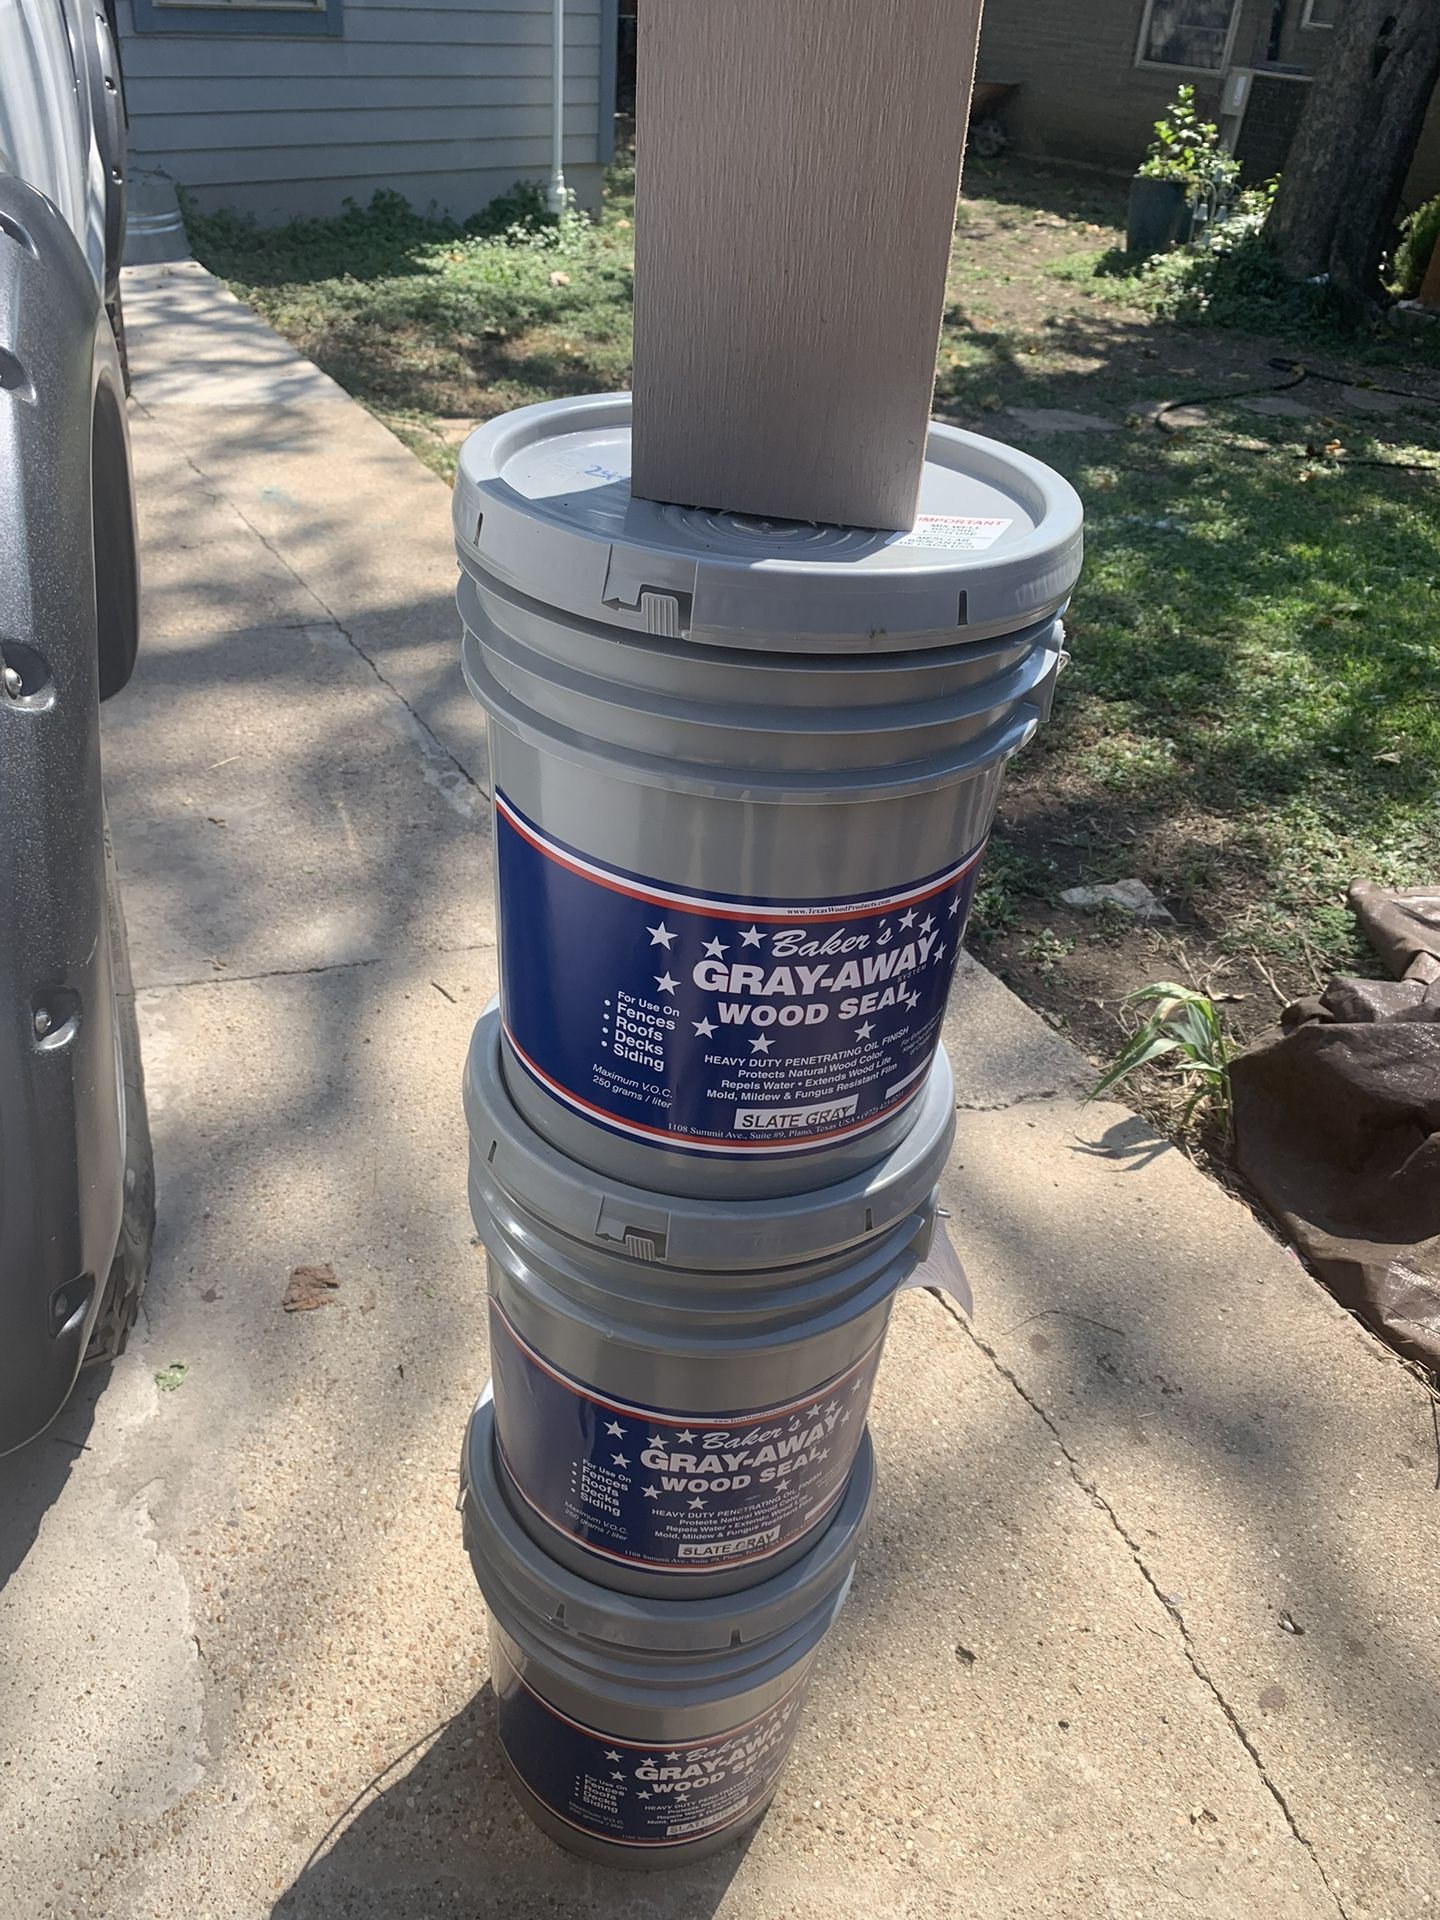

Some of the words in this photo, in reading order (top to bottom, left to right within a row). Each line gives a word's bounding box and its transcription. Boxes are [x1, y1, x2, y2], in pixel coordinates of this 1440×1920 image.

[918, 517, 1003, 526] IMPORTANT
[787, 898, 892, 915] www.TexasWoodProducts.com
[771, 918, 894, 958] Baker's
[692, 928, 940, 996] GRAY-AWAY
[617, 990, 636, 1004] For
[638, 998, 660, 1012] Use
[663, 1006, 680, 1017] On
[617, 1001, 676, 1030] Fences
[717, 1001, 830, 1027] WOOD
[838, 982, 912, 1020] SEAL
[616, 1015, 663, 1042] Roofs
[614, 1029, 664, 1056] Decks
[704, 1054, 746, 1066] HEAVY
[749, 1059, 782, 1067] DUTY
[785, 1046, 862, 1067] PENETRATING
[864, 1041, 879, 1052] OIL
[881, 1026, 910, 1046] FINISH
[613, 1043, 665, 1072] Siding
[738, 1069, 785, 1079] Protects
[788, 1065, 827, 1078] Natural
[829, 1060, 857, 1073] Wood
[859, 1050, 884, 1064] Color
[592, 1063, 639, 1088] Maximum
[642, 1082, 673, 1099] V.O.C.
[706, 1089, 738, 1101] Mold,
[740, 1092, 780, 1101] Mildew
[783, 1092, 792, 1100] &
[795, 1087, 834, 1099] Fungus
[836, 1071, 880, 1092] Resistant
[881, 1063, 898, 1077] Film
[721, 1079, 760, 1091] Repels
[763, 1081, 795, 1090] Water
[805, 1072, 846, 1087] Extends
[848, 1064, 874, 1078] Wood
[876, 1056, 892, 1069] Life
[592, 1074, 611, 1089] 250
[612, 1085, 643, 1102] grams
[652, 1096, 673, 1109] liter
[668, 1122, 688, 1133] 1108
[690, 1127, 724, 1138] Summit
[749, 1131, 771, 1139] Suite
[816, 1123, 837, 1133] Texas
[838, 1117, 856, 1127] USA
[742, 1112, 802, 1129] SLATE
[806, 1104, 855, 1125] GRAY
[640, 1405, 844, 1474] GRAY-AWAY
[702, 1415, 802, 1450] Baker's
[582, 1458, 597, 1470] For
[598, 1466, 616, 1478] Use
[618, 1474, 632, 1483] On
[582, 1465, 629, 1491] Fences
[660, 1475, 751, 1494] WOOD
[759, 1447, 820, 1483] SEAL
[581, 1474, 619, 1497] Roofs
[581, 1483, 620, 1506] Decks
[580, 1491, 621, 1517] Siding
[651, 1508, 686, 1519] HEAVY
[720, 1513, 753, 1524] Natural
[754, 1505, 778, 1516] Wood
[666, 1525, 698, 1533] Repels
[734, 1515, 769, 1529] Extends
[726, 1524, 759, 1537] Fungus
[682, 1543, 732, 1556] SLATE
[735, 1531, 775, 1550] GRAY
[652, 1771, 726, 1793] WOOD
